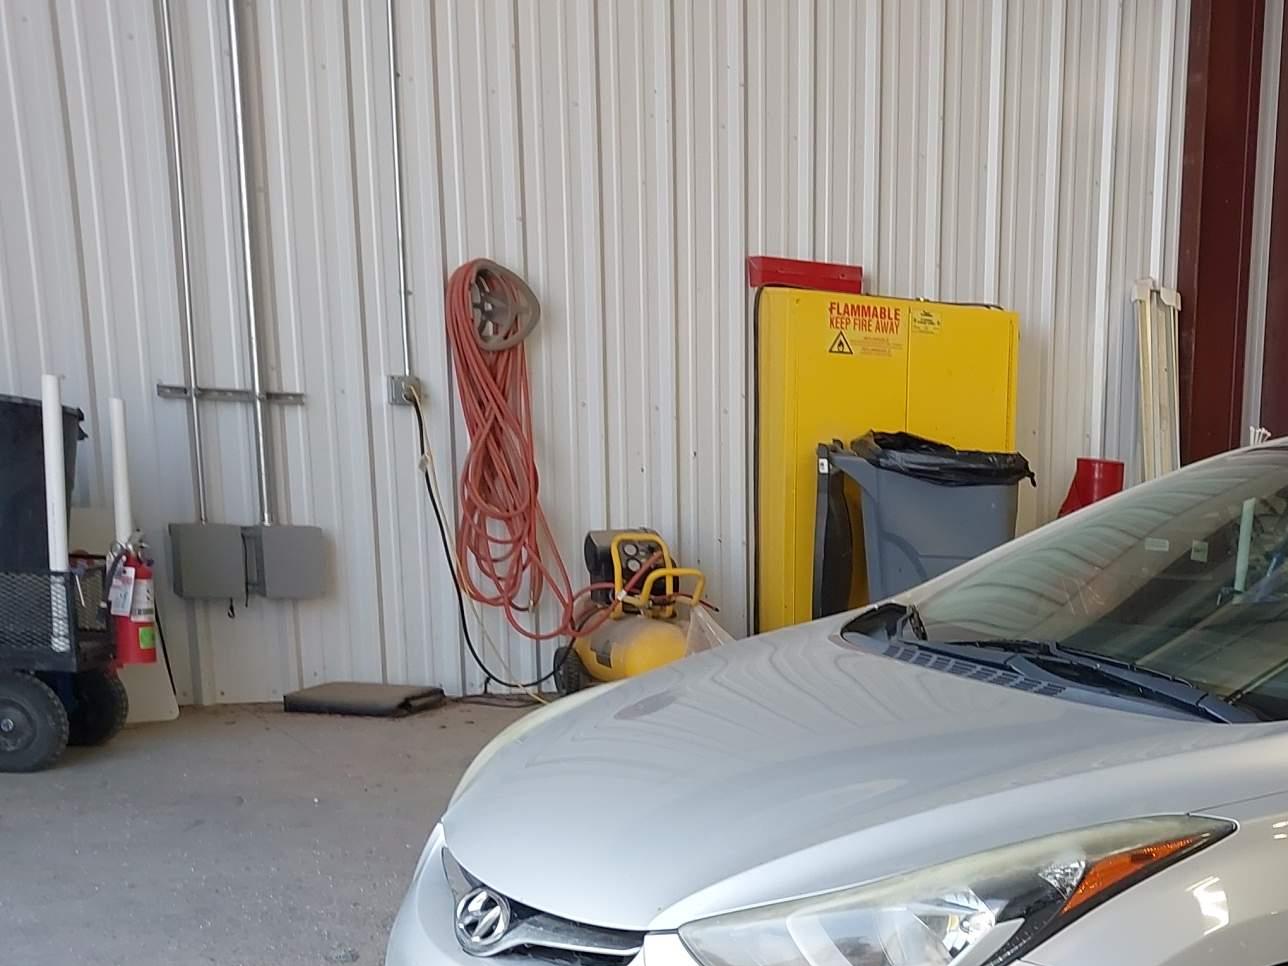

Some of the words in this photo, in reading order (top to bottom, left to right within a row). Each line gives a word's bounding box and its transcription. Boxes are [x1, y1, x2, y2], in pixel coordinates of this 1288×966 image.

[828, 301, 900, 321] FLAMMABLE
[829, 316, 851, 330] KEEP
[853, 318, 872, 333] FIRE
[875, 320, 900, 335] AWAY
